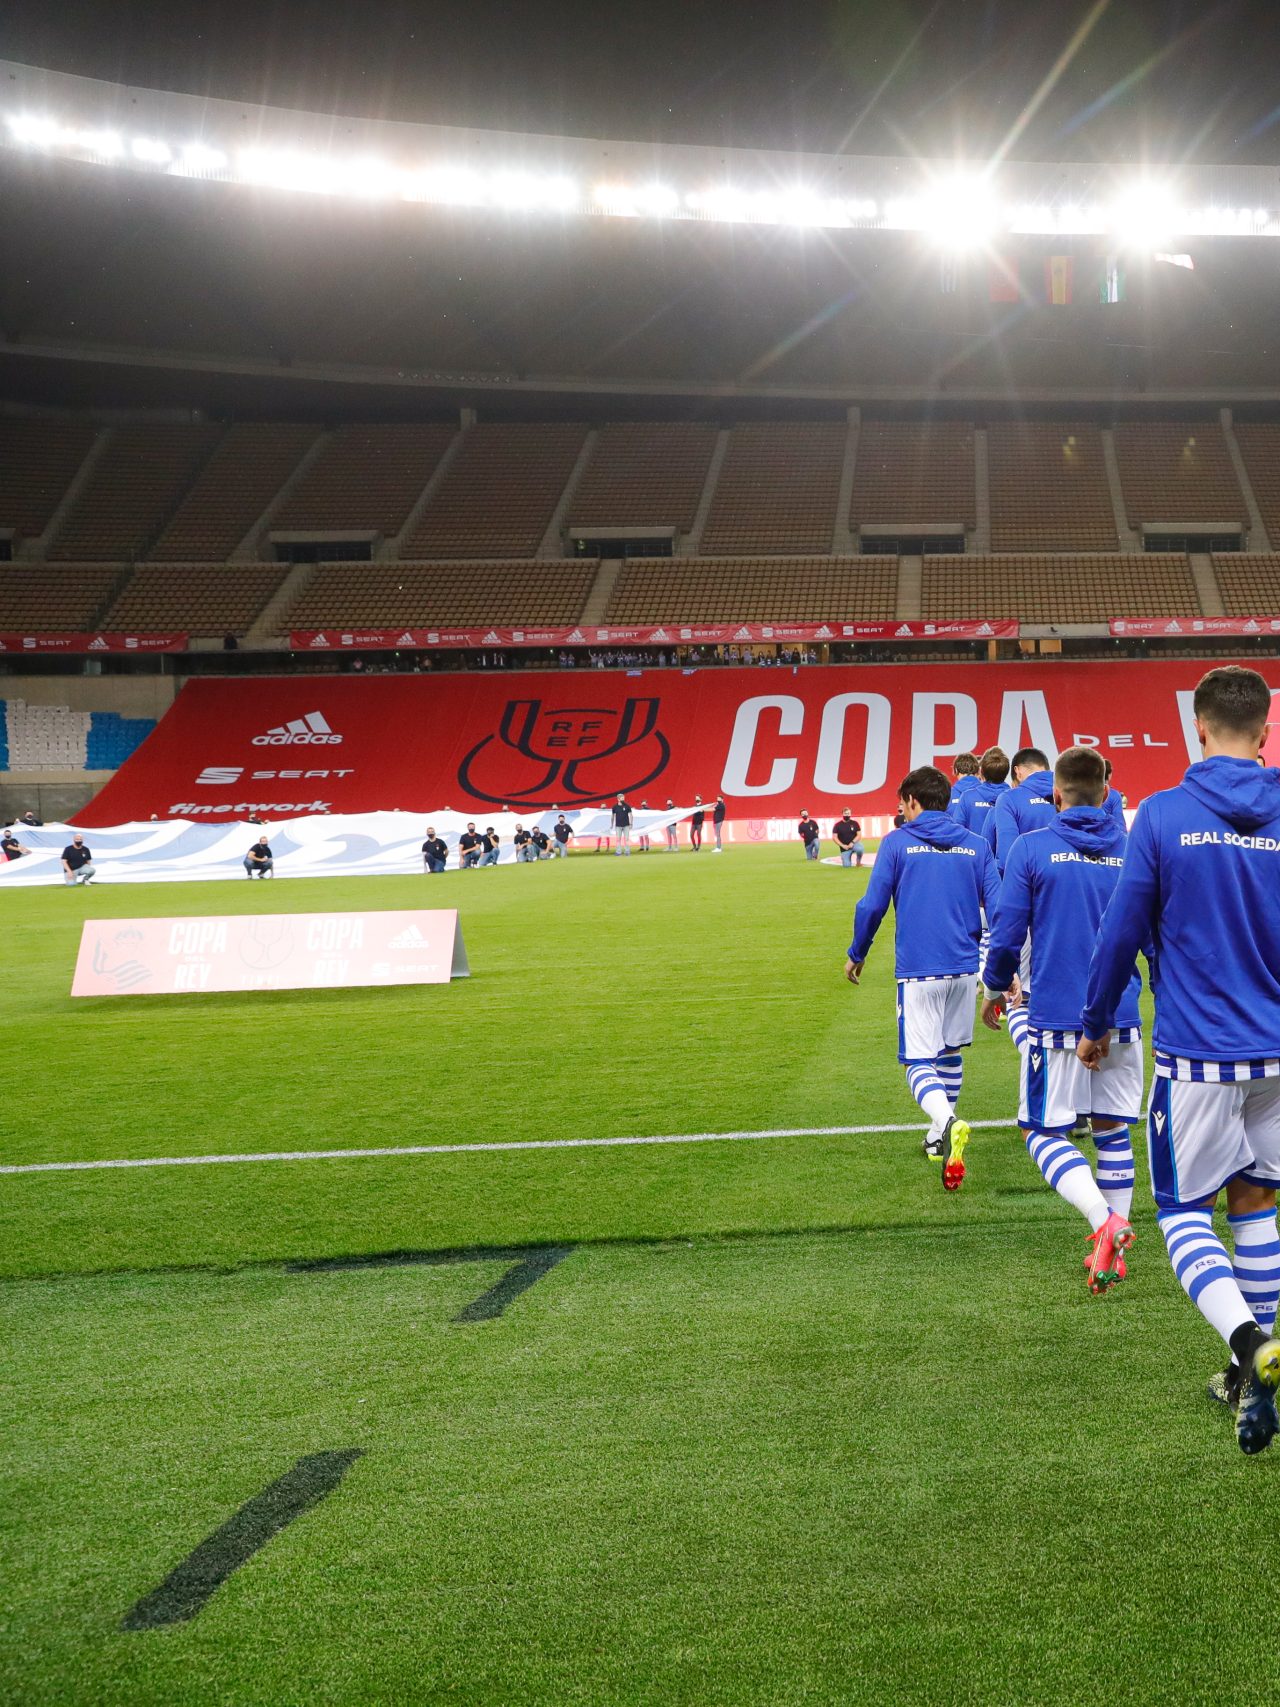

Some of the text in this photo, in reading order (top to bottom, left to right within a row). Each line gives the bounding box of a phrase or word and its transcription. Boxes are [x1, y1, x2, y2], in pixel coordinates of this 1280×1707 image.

[356, 634, 385, 643] SEAT
[526, 631, 555, 639] SEAT
[610, 630, 639, 638] SEAT
[694, 628, 723, 637] SEAT
[551, 721, 603, 732] RF
[252, 730, 343, 745] adidas
[546, 736, 599, 747] EF
[720, 690, 1169, 797] COPA DEL
[251, 768, 354, 780] SEAT
[168, 800, 333, 815] finetwork
[1180, 831, 1222, 846] REAL
[906, 846, 931, 854] REAL
[1051, 852, 1124, 867] REAL SOCIED
[169, 921, 226, 954] COPA
[307, 919, 364, 952] COPA
[174, 963, 212, 989] REY
[312, 960, 350, 984] REY
[1195, 1259, 1216, 1270] RS
